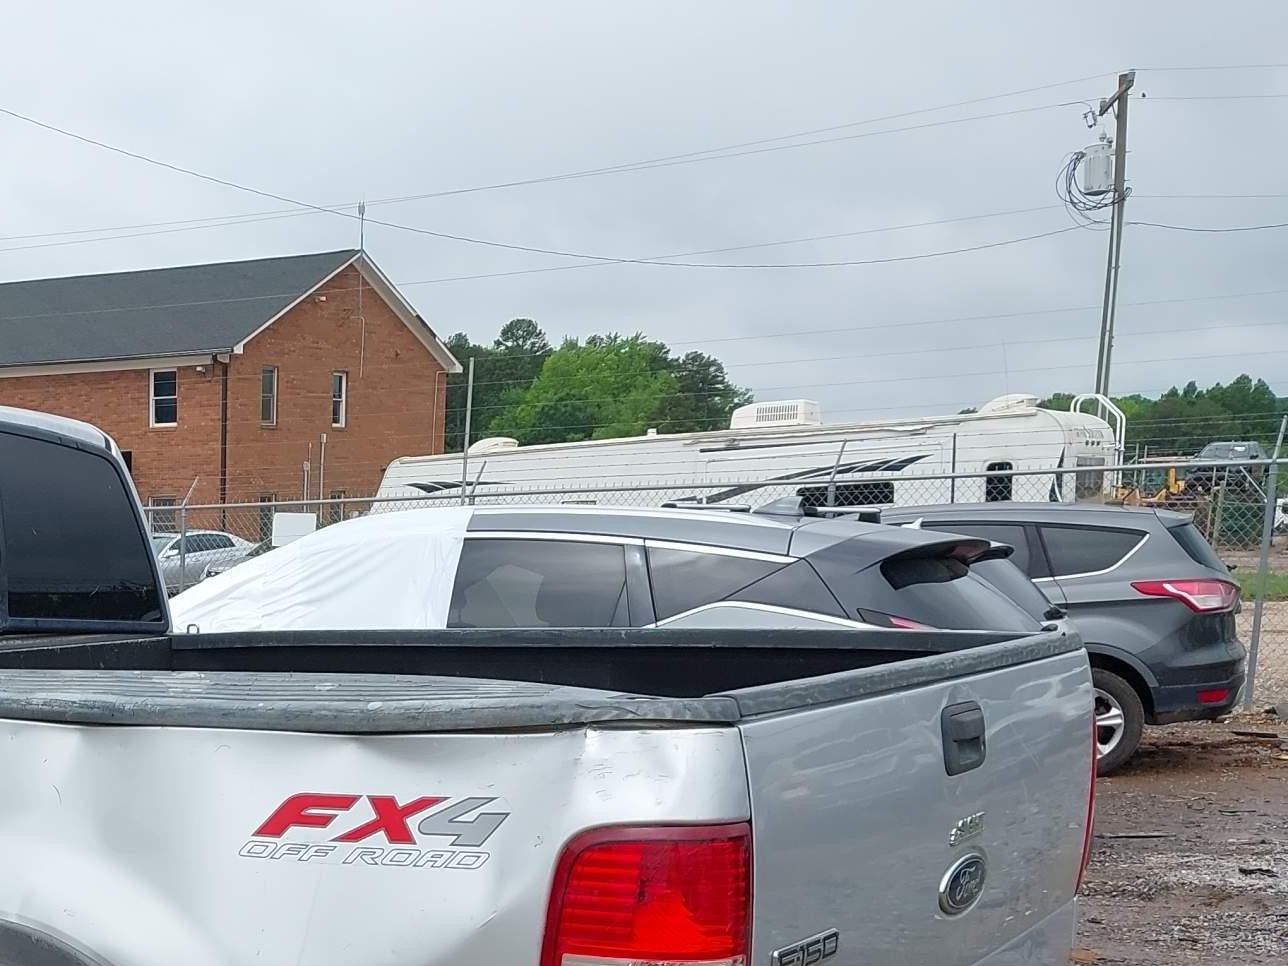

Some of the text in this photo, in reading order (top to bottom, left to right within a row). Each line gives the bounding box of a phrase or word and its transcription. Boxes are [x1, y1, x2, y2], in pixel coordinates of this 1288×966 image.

[251, 793, 511, 847] FX4
[238, 840, 491, 870] OFF ROAD
